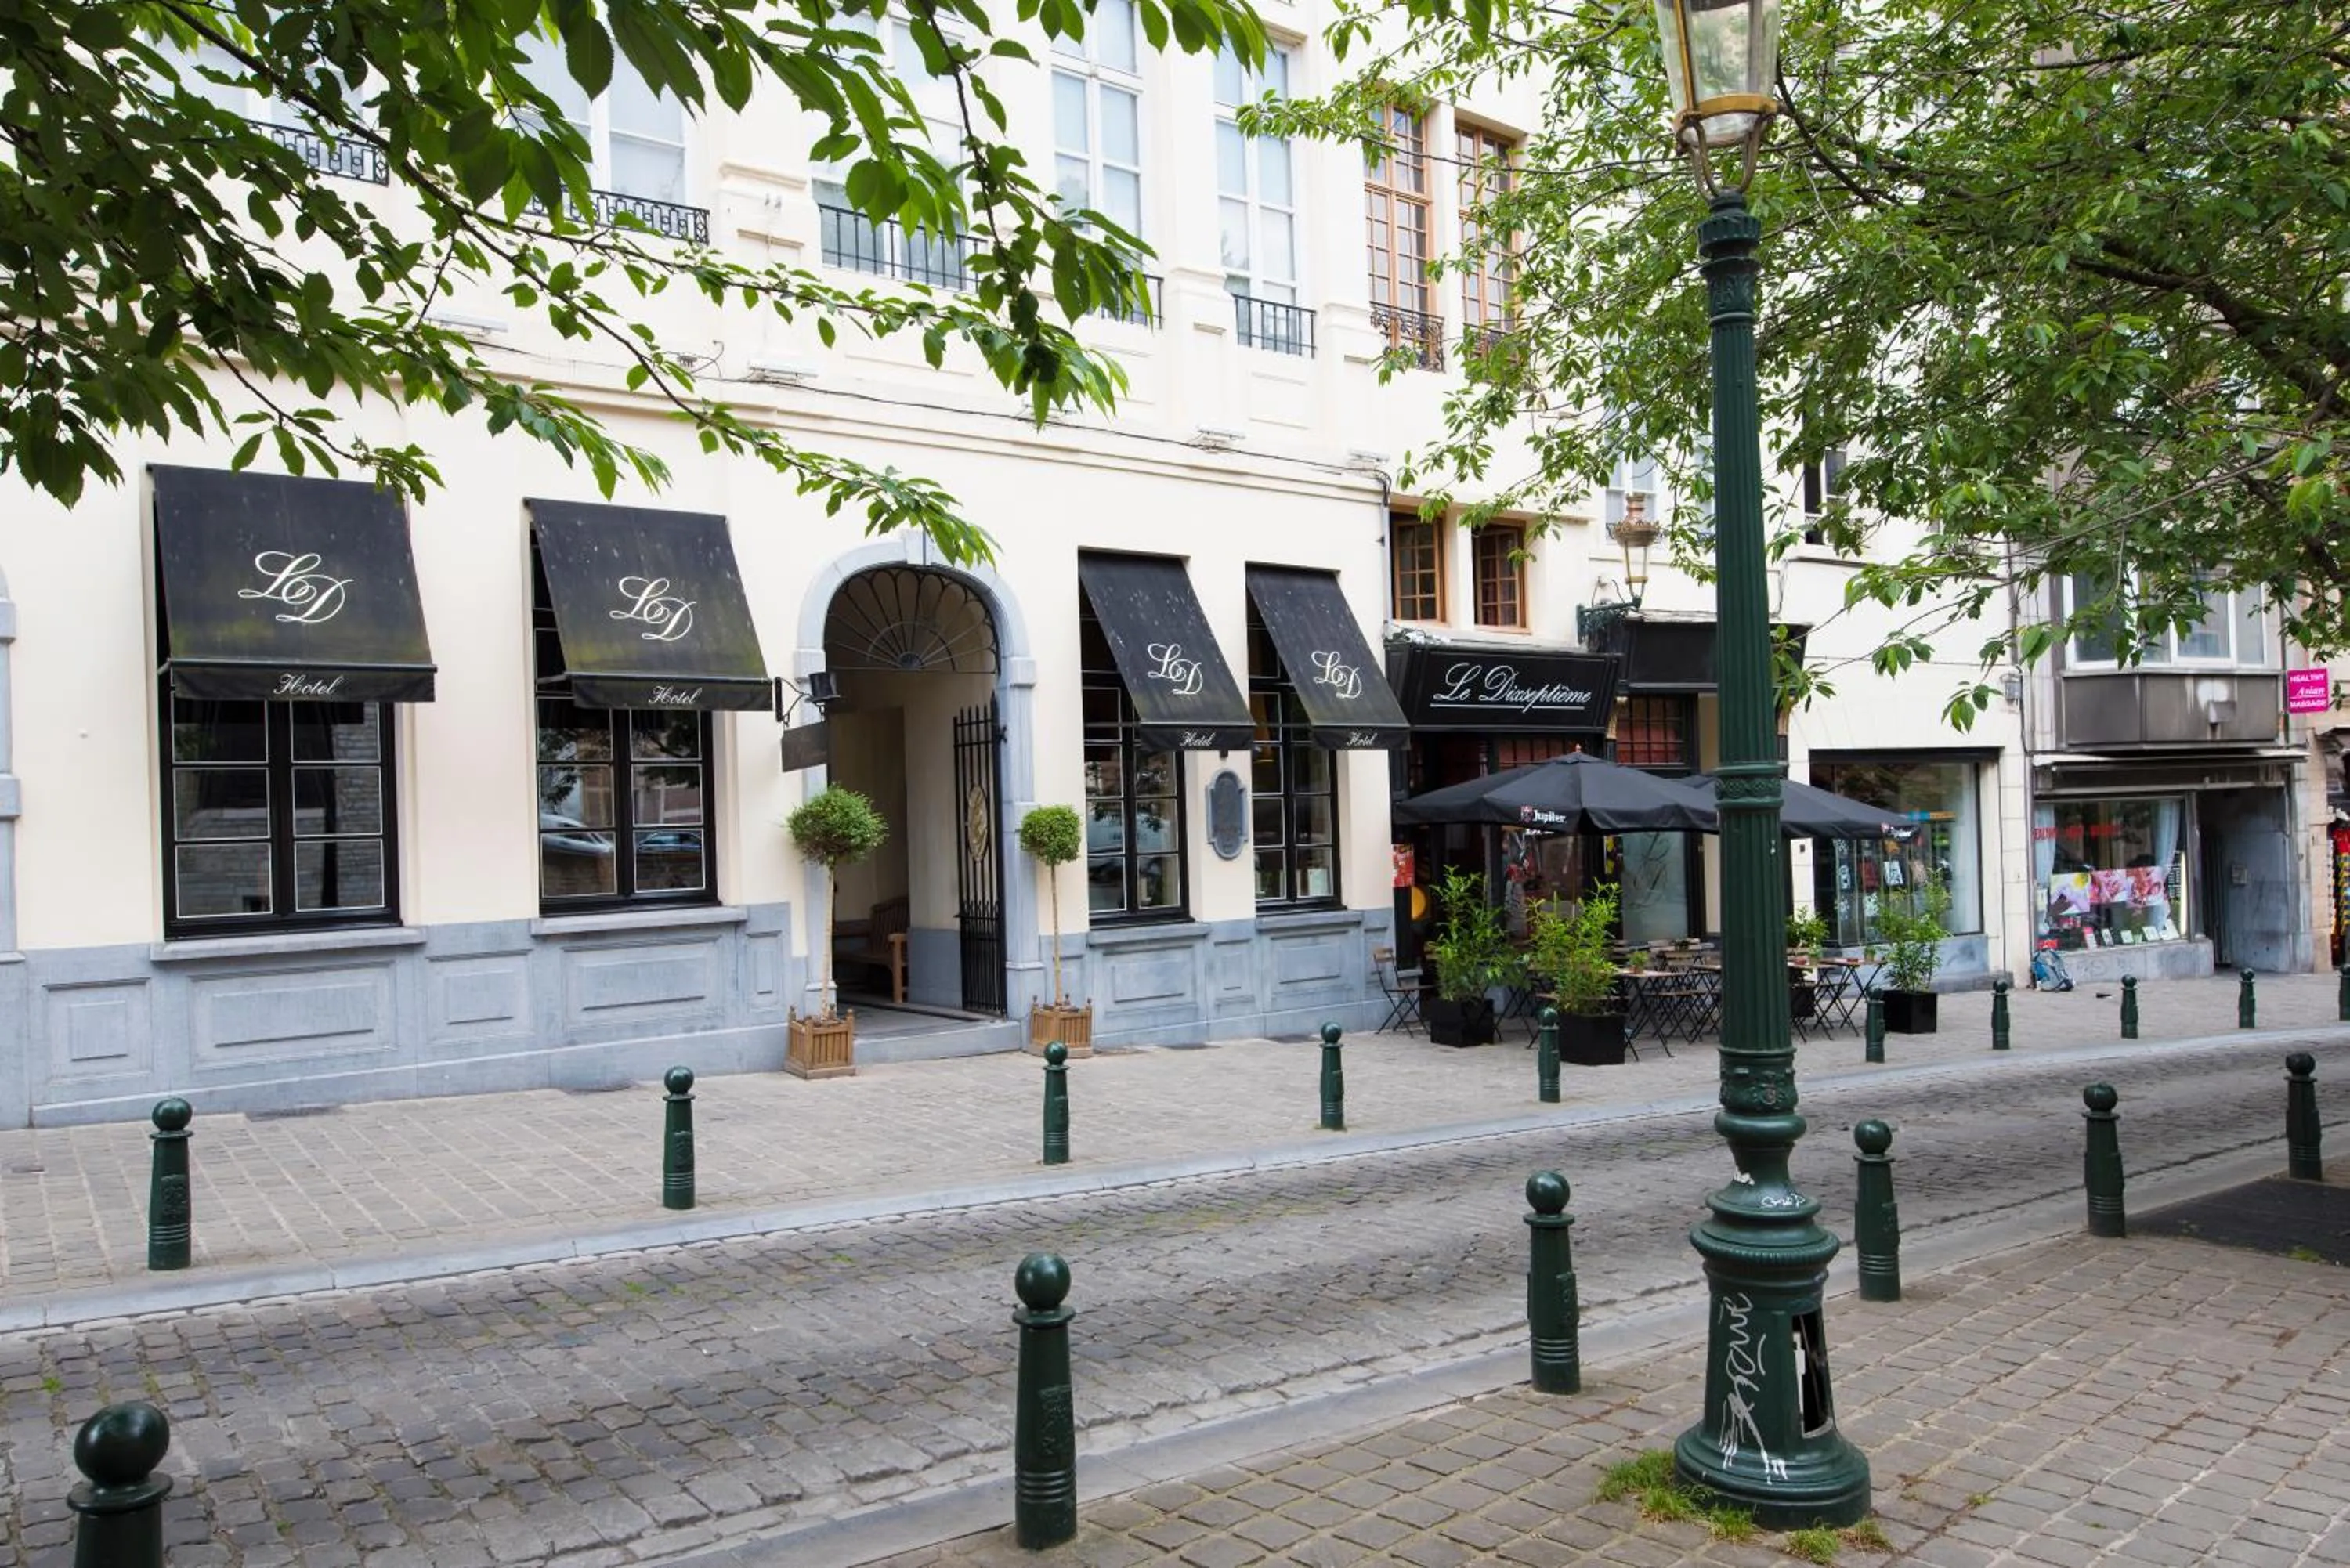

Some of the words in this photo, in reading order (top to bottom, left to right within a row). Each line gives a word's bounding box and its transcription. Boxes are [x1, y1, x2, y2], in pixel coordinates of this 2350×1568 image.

[273, 673, 345, 695] Hotel
[1433, 662, 1481, 701] Le
[648, 685, 703, 704] Hotel
[1179, 731, 1216, 746] Hotel
[1347, 732, 1378, 746] Hotel
